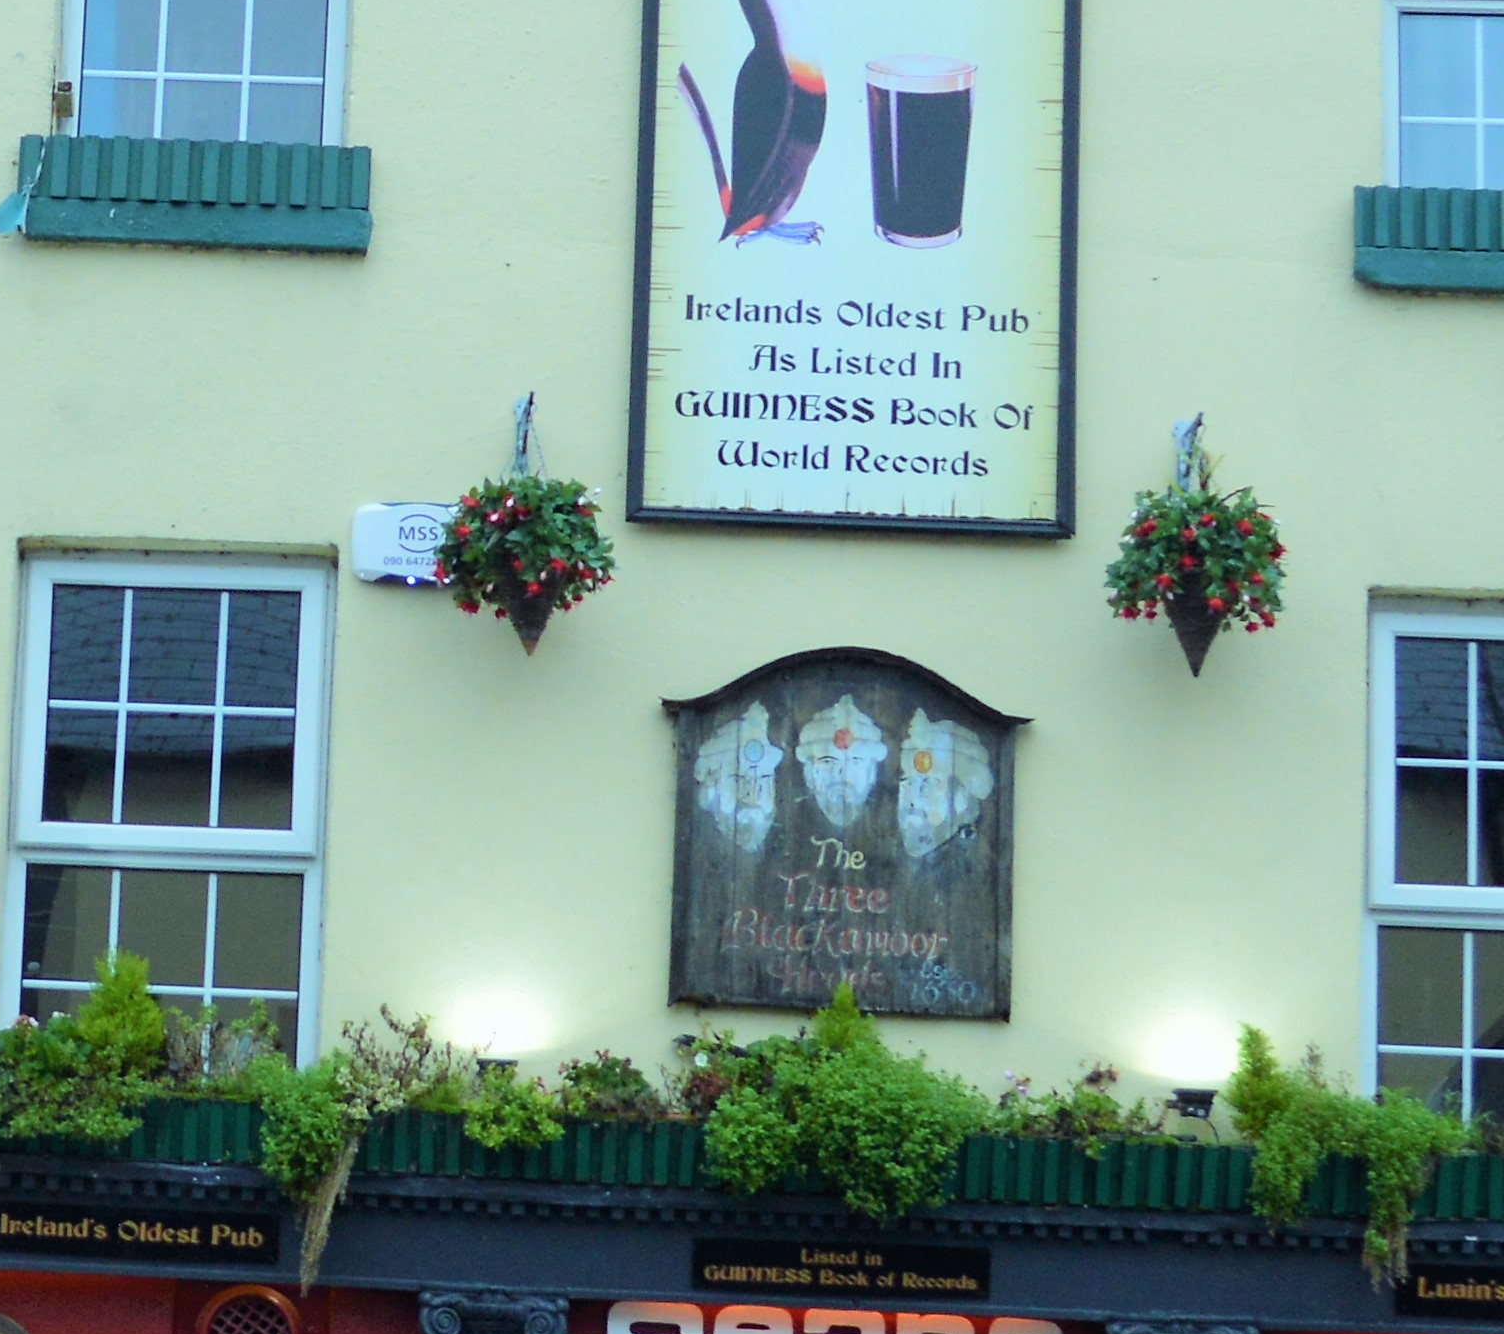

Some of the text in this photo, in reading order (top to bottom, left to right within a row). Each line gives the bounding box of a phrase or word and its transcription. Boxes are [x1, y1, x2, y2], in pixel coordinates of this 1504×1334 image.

[685, 294, 1030, 334] Irelands Oldest Pub
[749, 344, 962, 379] As Listed In
[675, 390, 1034, 431] GUINNESS Book Of
[717, 439, 989, 477] World Records
[398, 525, 439, 541] MSS
[810, 835, 867, 870] The
[777, 873, 891, 915] Three
[0, 1213, 265, 1248] Ireland's Oldest Pub
[800, 1247, 884, 1267] Listed in
[703, 1264, 978, 1291] GUINNESS Book of Records
